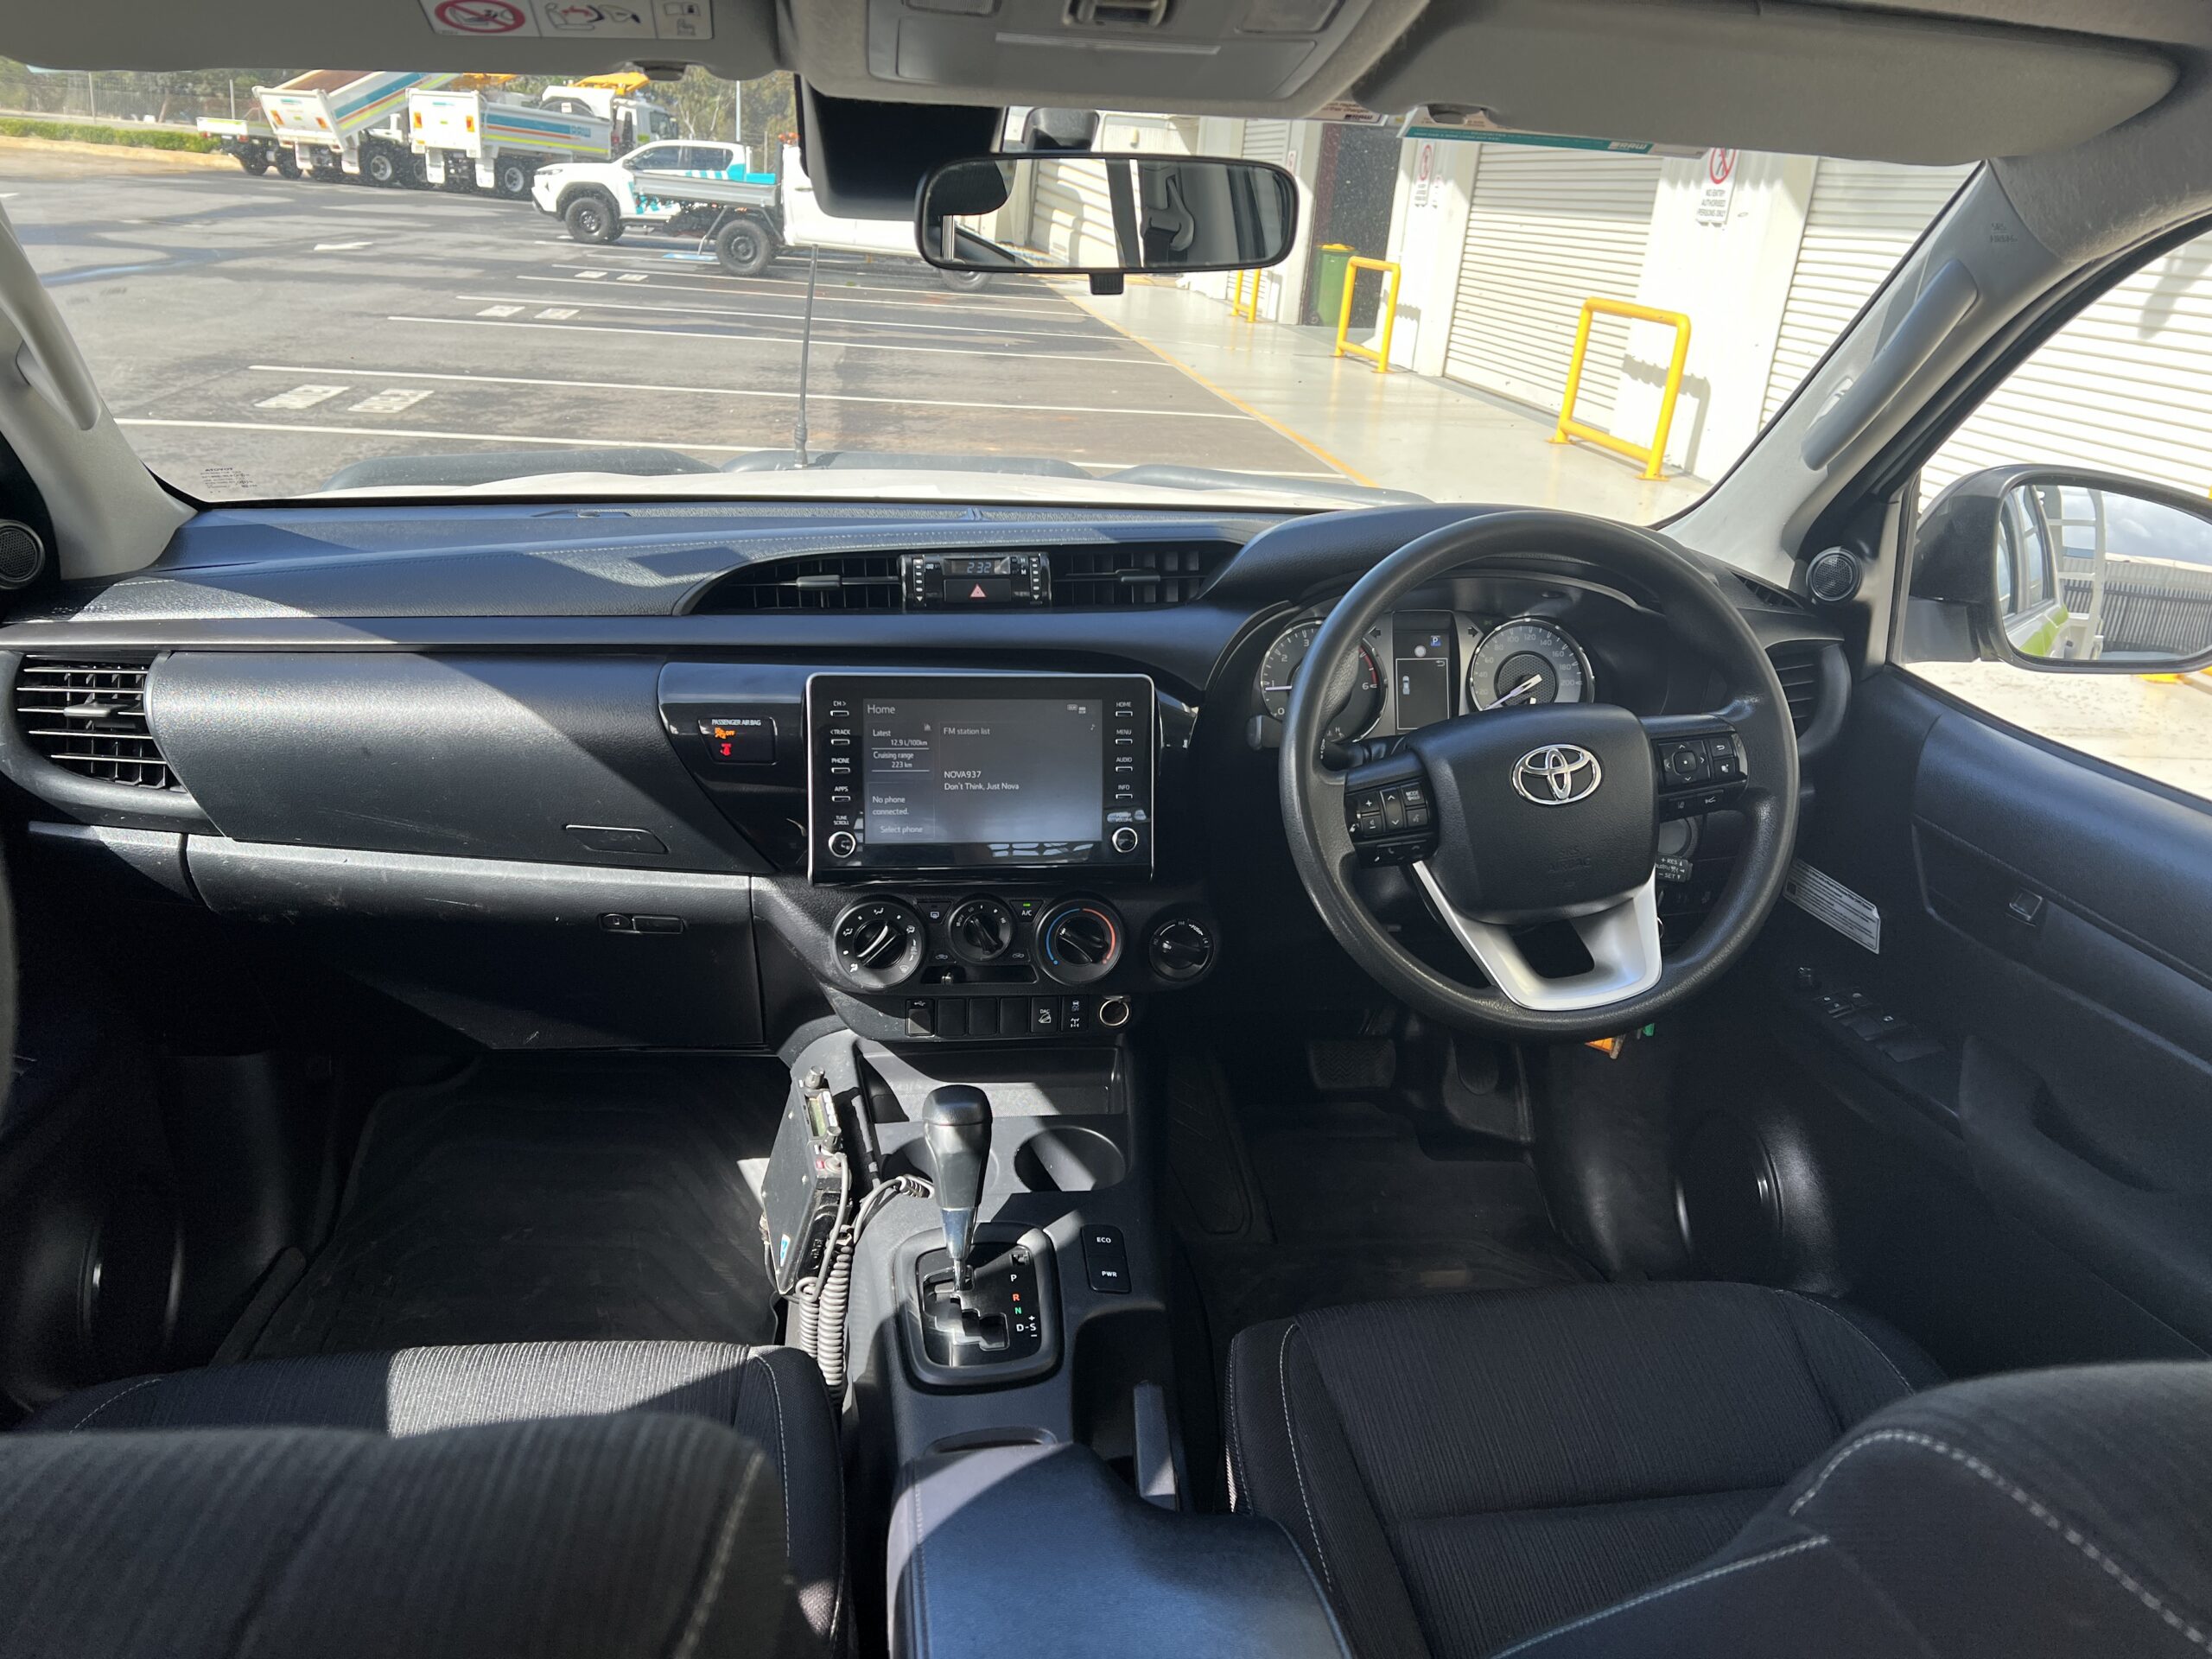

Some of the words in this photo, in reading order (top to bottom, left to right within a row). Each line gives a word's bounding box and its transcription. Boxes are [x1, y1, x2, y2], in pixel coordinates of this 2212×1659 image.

[1303, 639, 1310, 647] 3
[1362, 682, 1370, 690] 6
[867, 704, 896, 715] Home
[981, 727, 990, 735] list
[873, 751, 897, 760] Cruising
[986, 782, 1001, 791] Just
[884, 796, 906, 804] phone
[901, 826, 923, 835] phone
[1010, 1274, 1018, 1282] P
[1013, 1294, 1020, 1302] R
